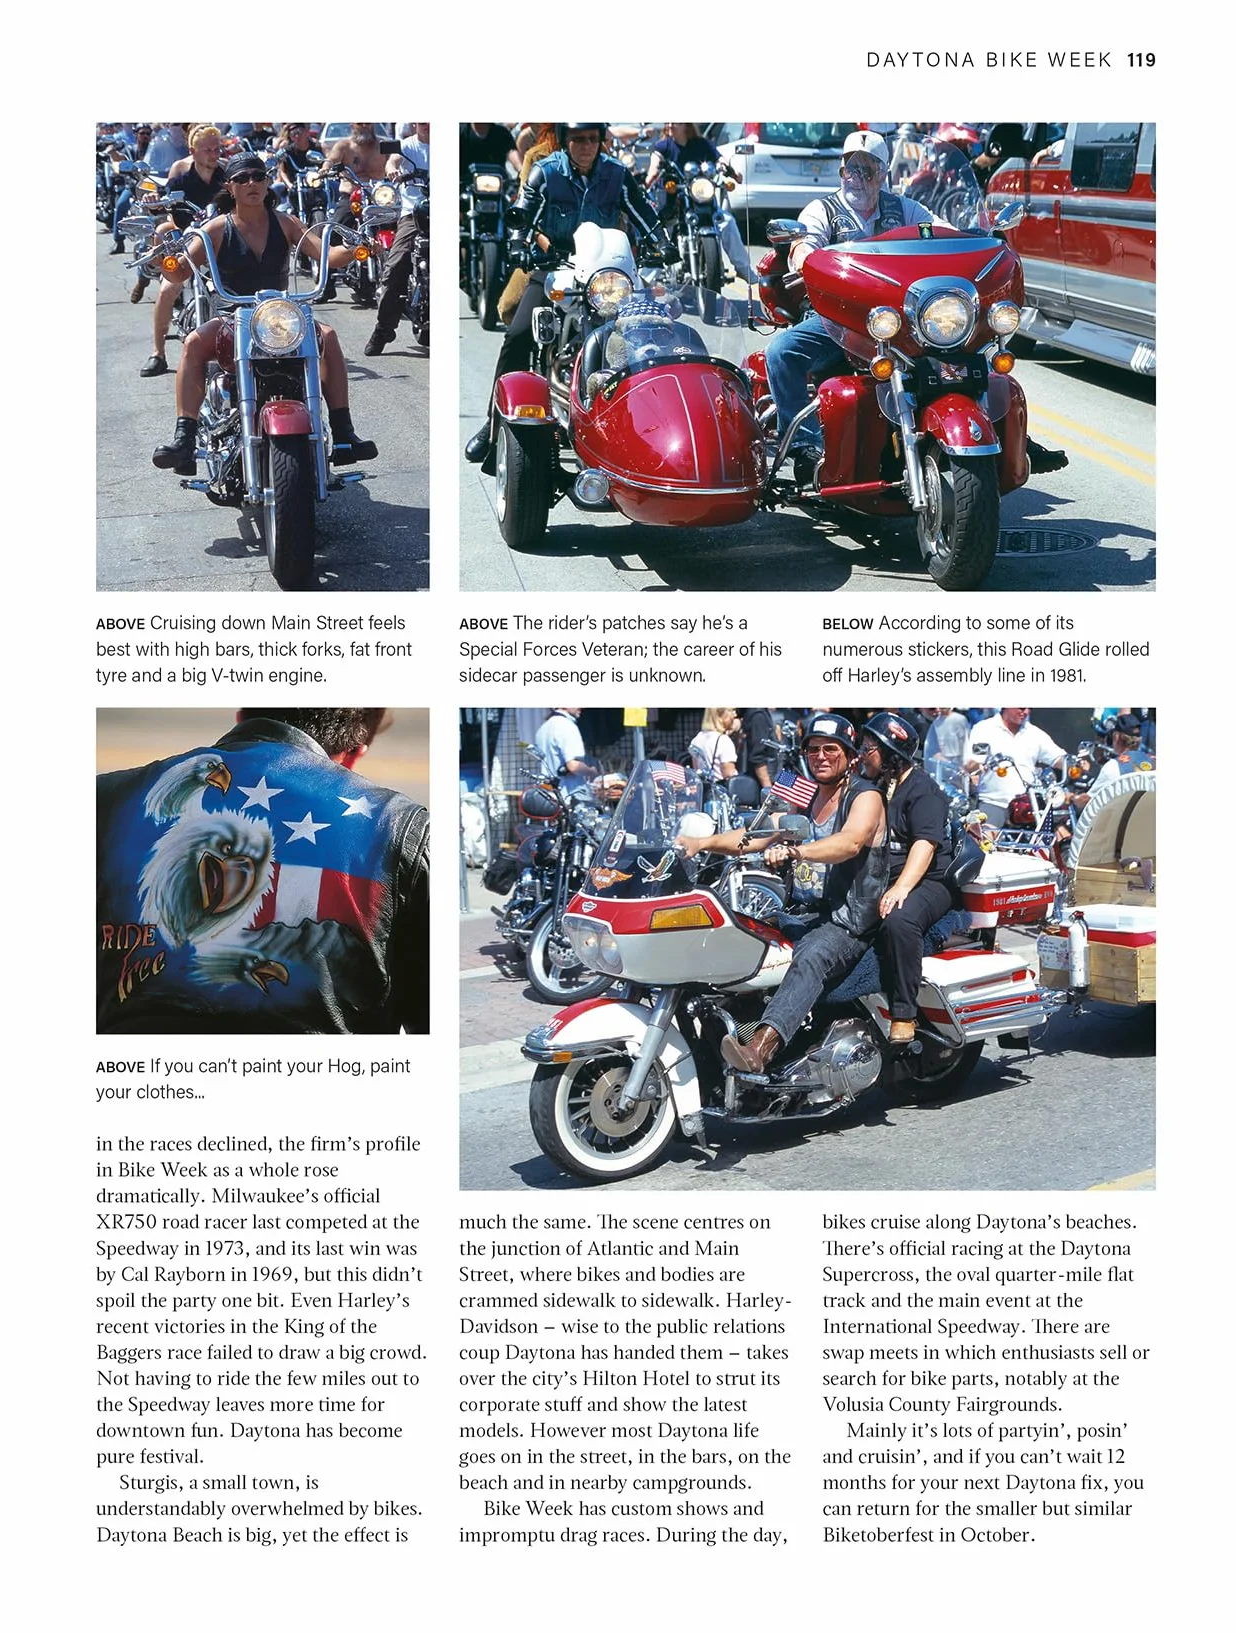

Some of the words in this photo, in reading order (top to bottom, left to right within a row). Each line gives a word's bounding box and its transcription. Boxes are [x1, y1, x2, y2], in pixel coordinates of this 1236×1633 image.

[867, 51, 975, 68] DAYTONA
[986, 51, 1037, 68] BIKE
[1047, 51, 1111, 68] WEEK
[1127, 52, 1156, 68] 119
[96, 641, 131, 657] best
[135, 641, 170, 657] with
[175, 640, 210, 660] high
[215, 641, 254, 659] bars,
[258, 641, 298, 657] thick
[301, 640, 345, 659] forks,
[349, 640, 371, 657] fat
[374, 640, 413, 657] front
[823, 644, 903, 657] numerous
[908, 641, 973, 659] stickers,
[976, 640, 1007, 657] this
[1011, 640, 1053, 657] Road
[1058, 640, 1100, 657] Glide
[1105, 640, 1150, 657] rolled
[459, 666, 518, 683] sidecar
[523, 670, 607, 687] passenger
[611, 667, 624, 683] is
[629, 667, 706, 683] unknown.
[101, 922, 156, 950] RIDE
[95, 1087, 132, 1103] your
[459, 1240, 486, 1256] the
[491, 1240, 561, 1260] junction
[565, 1239, 583, 1256] of
[587, 1240, 654, 1257] Atlantic
[658, 1240, 690, 1256] and
[694, 1240, 740, 1256] Main
[822, 1396, 884, 1412] Volusia
[888, 1396, 951, 1417] County
[956, 1396, 1062, 1417] Fairgrounds.
[97, 1452, 135, 1469] pure
[139, 1447, 204, 1464] festival.
[96, 1500, 226, 1521] understandably
[231, 1500, 344, 1516] overwhelmed
[348, 1500, 369, 1521] by
[373, 1500, 422, 1516] bikes.
[823, 1526, 934, 1543] Biketoberfest
[939, 1527, 956, 1543] in
[960, 1526, 1035, 1543] October.
